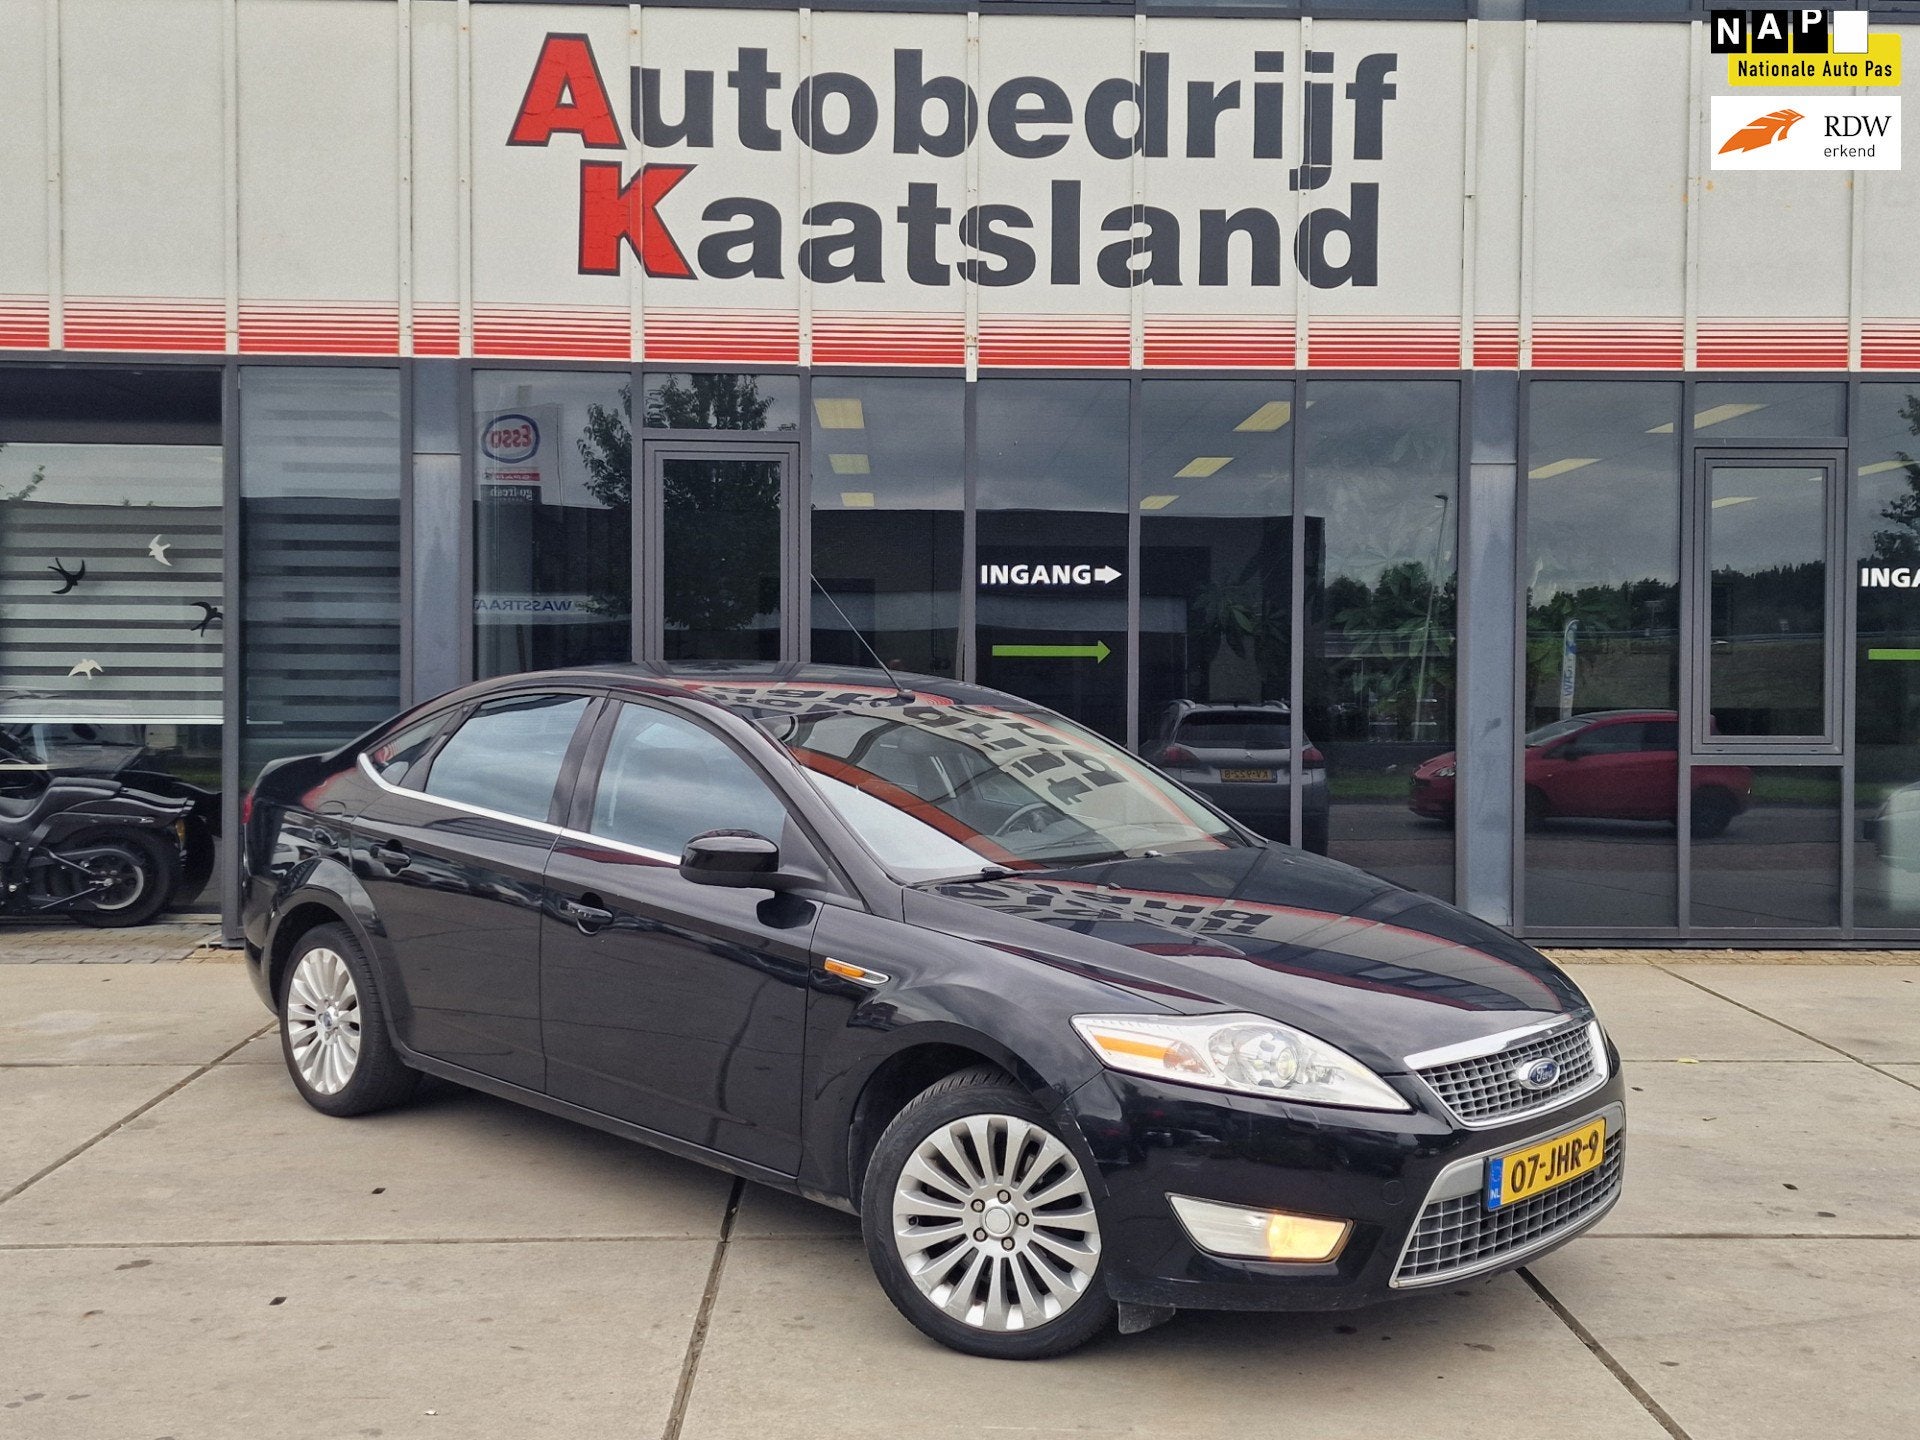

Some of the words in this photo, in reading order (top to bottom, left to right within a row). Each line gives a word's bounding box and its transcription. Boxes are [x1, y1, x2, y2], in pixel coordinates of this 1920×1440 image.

[506, 31, 1397, 191] Autobedrijf
[578, 159, 1379, 289] Kaatsland
[981, 564, 1092, 585] INGANG
[1490, 1187, 1501, 1199] NL
[1511, 1129, 1599, 1193] 07-JHR-9
